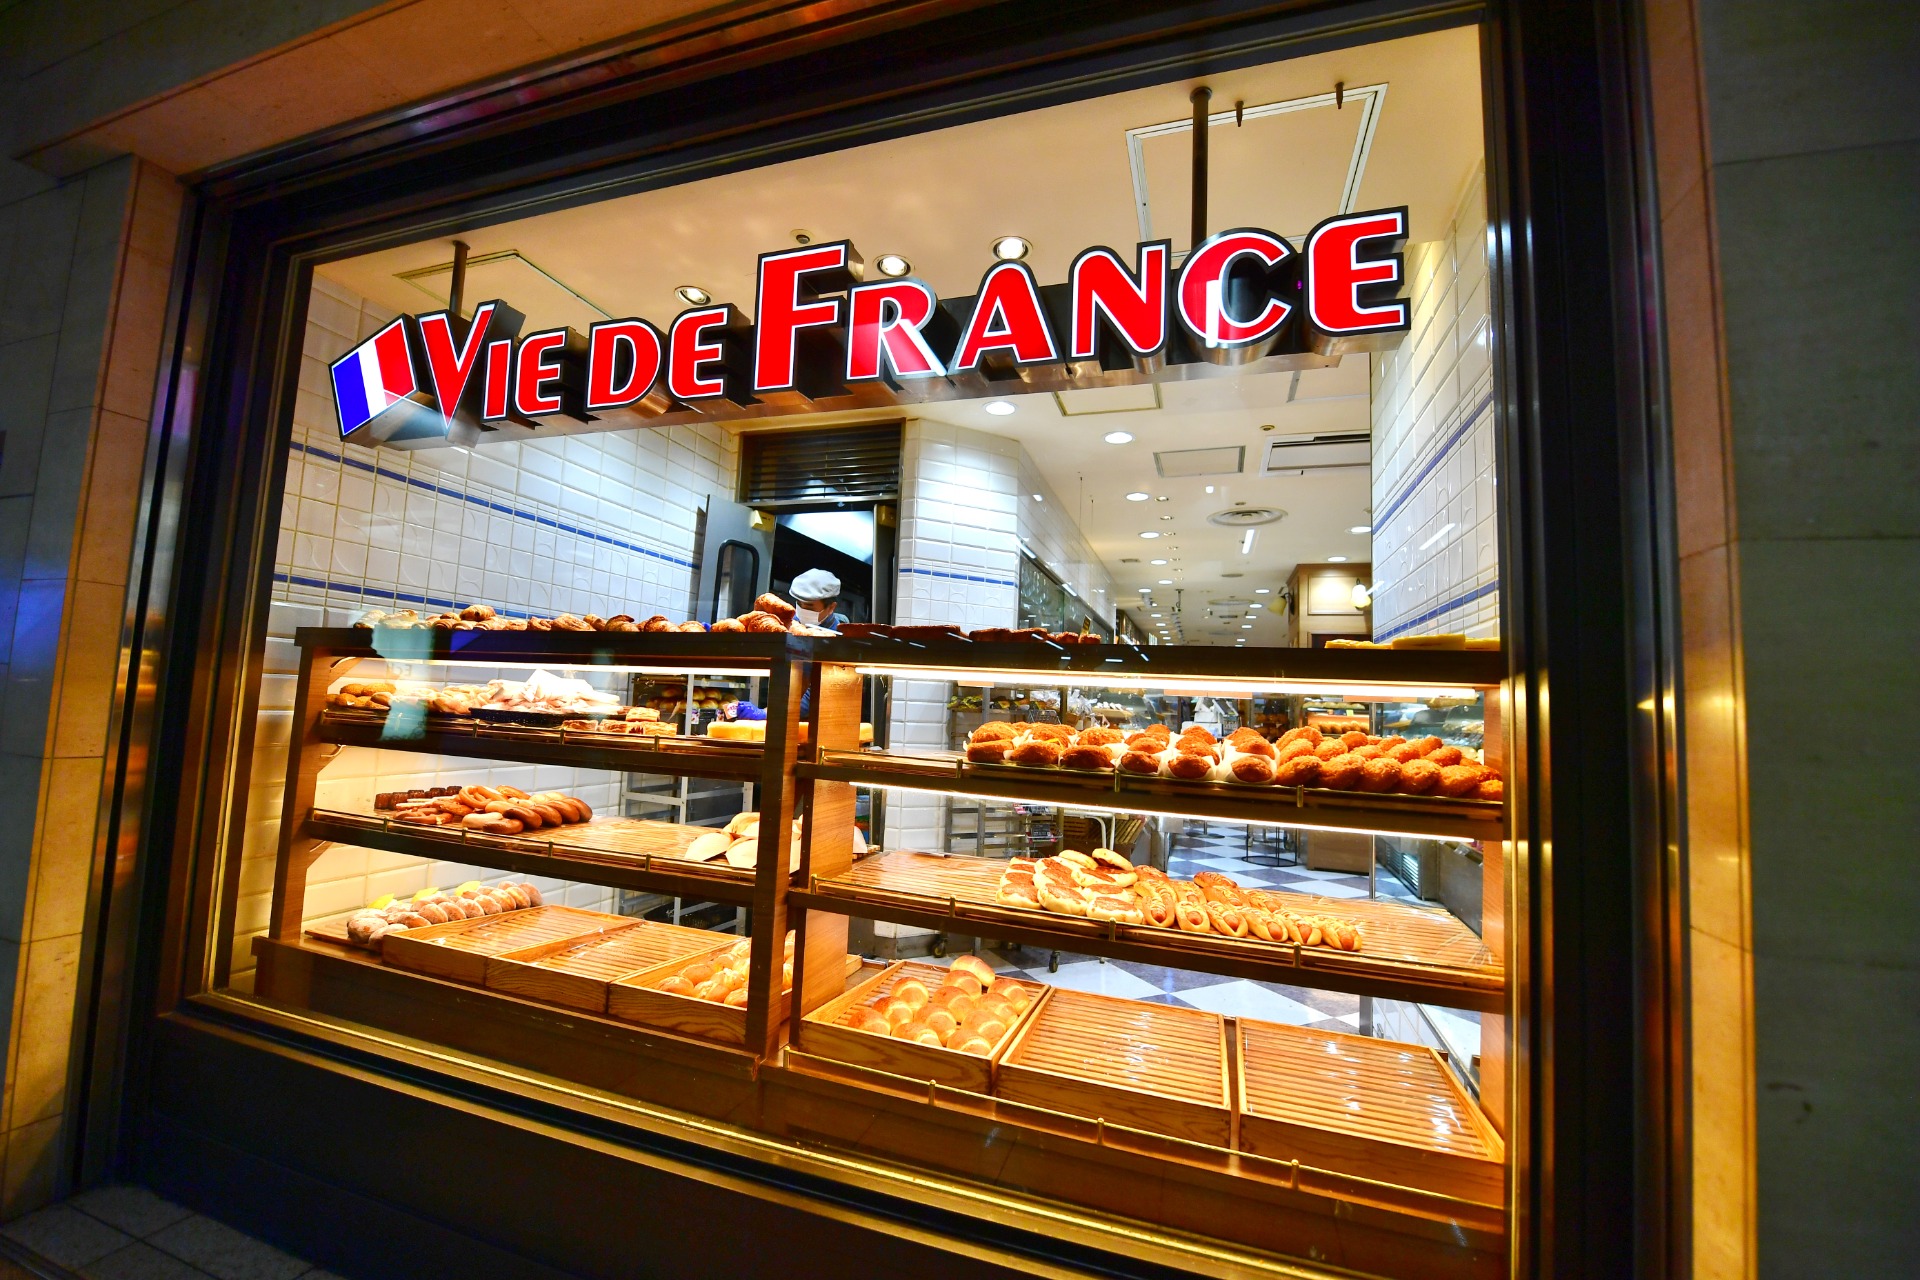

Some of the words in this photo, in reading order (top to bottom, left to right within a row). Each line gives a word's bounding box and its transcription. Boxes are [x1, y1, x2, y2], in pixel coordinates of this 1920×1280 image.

[415, 303, 567, 430] VIE
[587, 307, 729, 411] DE
[754, 211, 1406, 392] FRANCE
